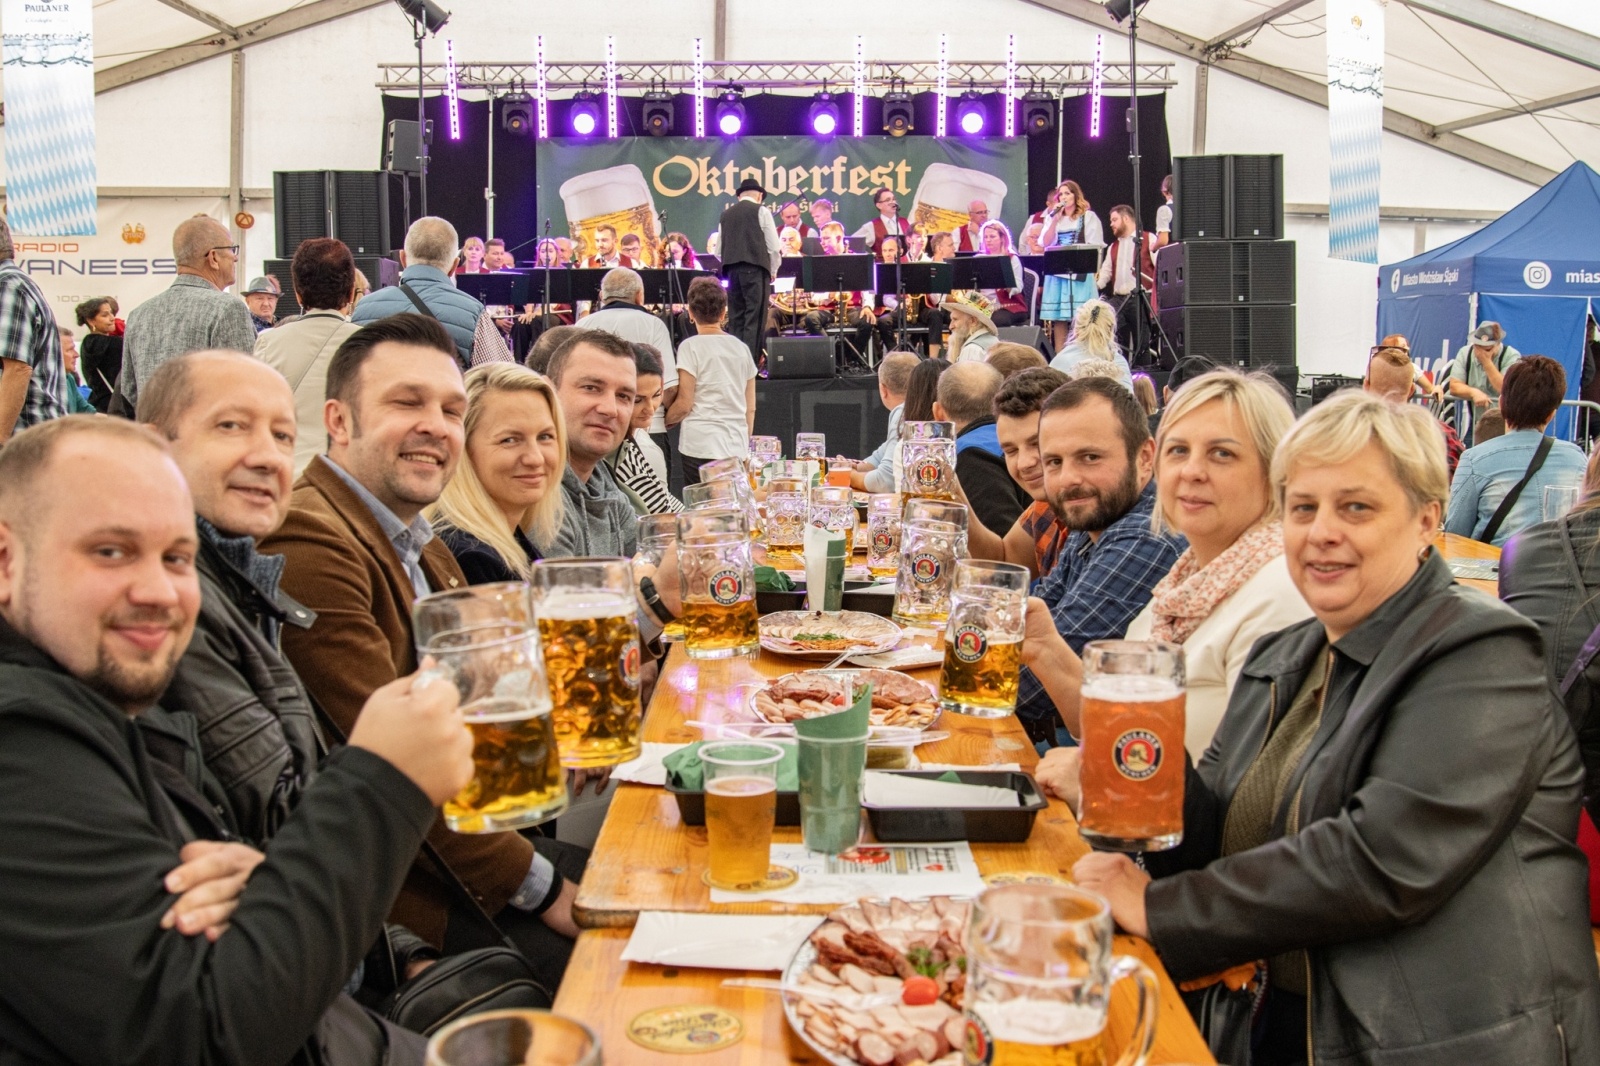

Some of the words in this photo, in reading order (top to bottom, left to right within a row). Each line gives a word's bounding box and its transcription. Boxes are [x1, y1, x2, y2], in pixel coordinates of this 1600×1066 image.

[25, 4, 70, 12] PAULANER
[652, 154, 912, 198] Oktoberfest
[1565, 269, 1600, 283] mias
[711, 571, 740, 585] PAULANER
[1116, 731, 1160, 749] PAULANER
